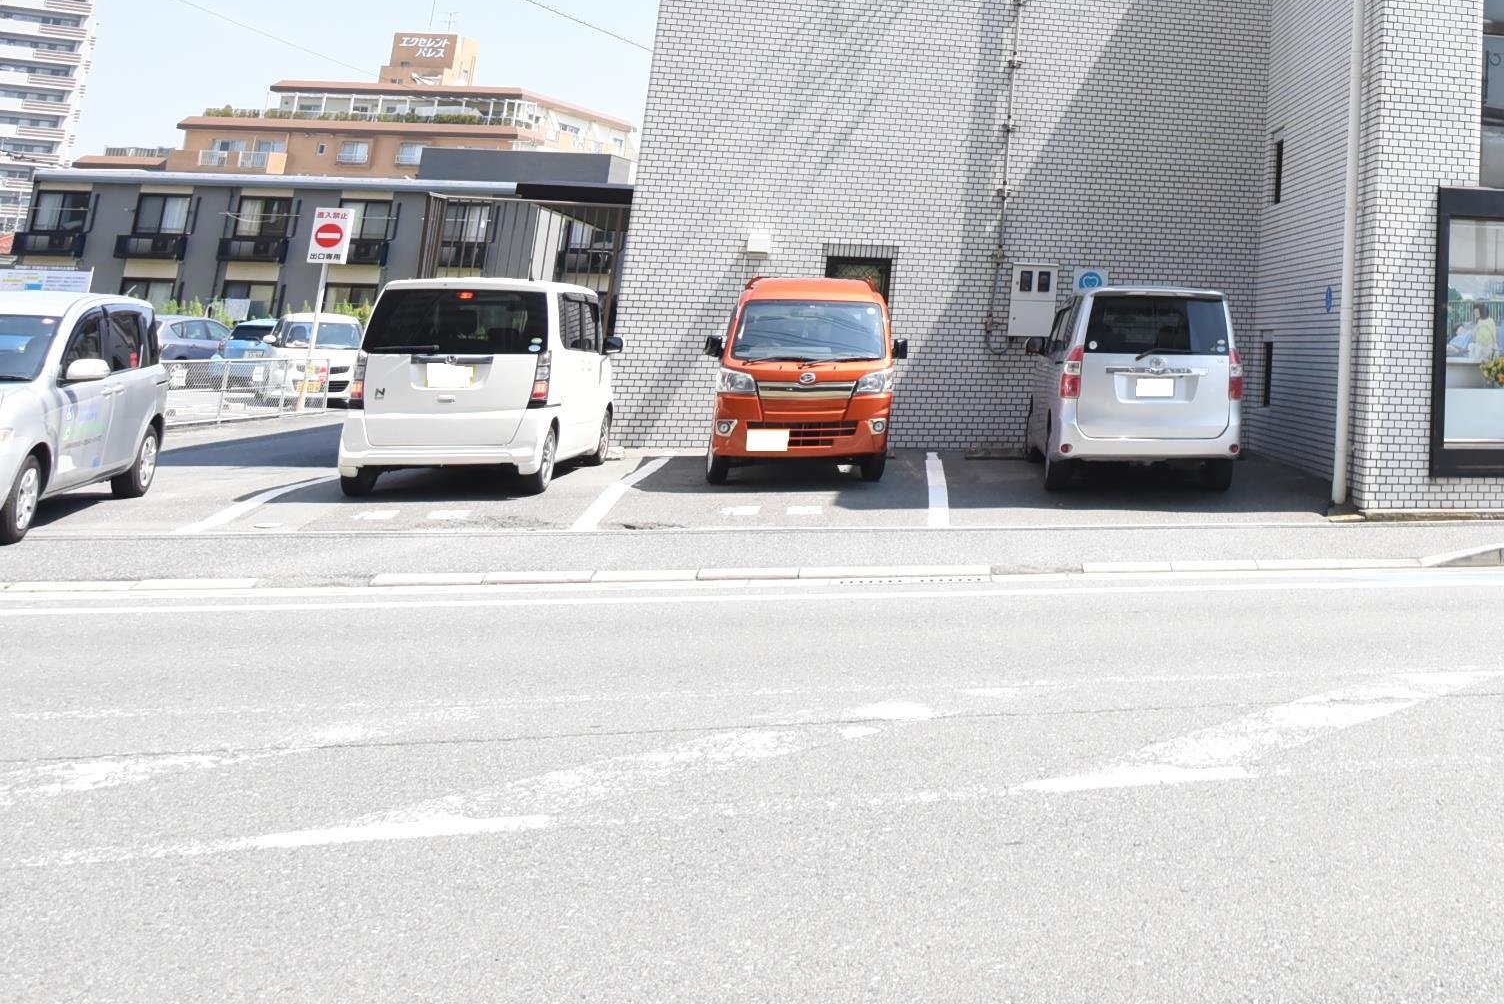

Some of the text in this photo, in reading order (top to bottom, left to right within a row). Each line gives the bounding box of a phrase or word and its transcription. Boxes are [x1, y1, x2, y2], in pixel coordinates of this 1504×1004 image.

[399, 37, 451, 48] エクセレント
[415, 47, 445, 58] パレス
